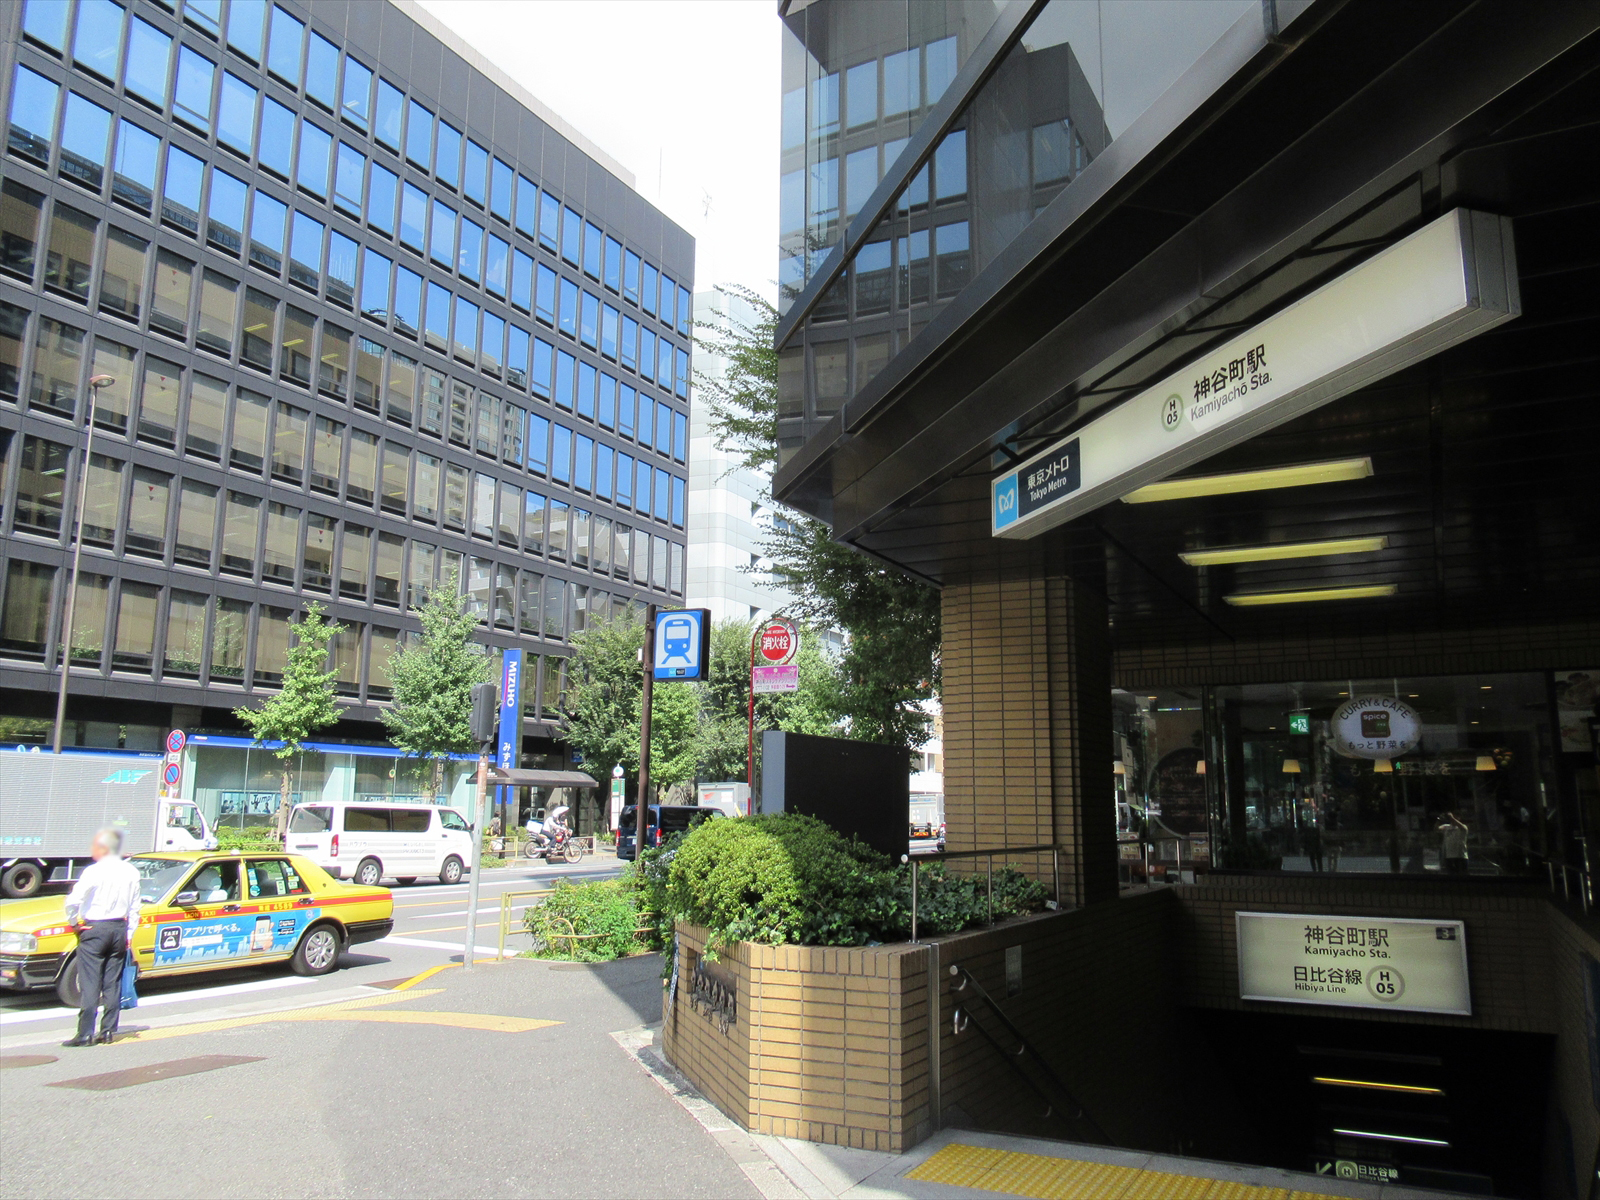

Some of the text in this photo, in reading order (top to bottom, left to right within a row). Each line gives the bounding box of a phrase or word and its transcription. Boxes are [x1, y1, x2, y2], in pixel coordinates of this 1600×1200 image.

[1193, 344, 1267, 403] 神谷町駅
[1250, 372, 1273, 391] Sta.
[1169, 400, 1176, 411] H
[1166, 411, 1178, 425] 05
[1027, 455, 1069, 491] 東京メトロ
[1030, 476, 1067, 502] Tokyo Metro
[763, 635, 789, 650] 消火栓
[506, 661, 518, 708] MIZUHO
[1348, 741, 1407, 750] もっと野菜を
[273, 902, 293, 910] 4589
[1304, 925, 1390, 948] 神谷町駅
[1442, 928, 1450, 939] 3
[1304, 945, 1391, 959] Kamiyacho Sta.
[1294, 966, 1363, 985] 日比谷線
[1379, 971, 1390, 982] H
[1294, 983, 1347, 994] Hibiya Line
[1376, 983, 1395, 995] 05
[1343, 1168, 1351, 1176] H
[1358, 1165, 1399, 1179] 日比谷線
